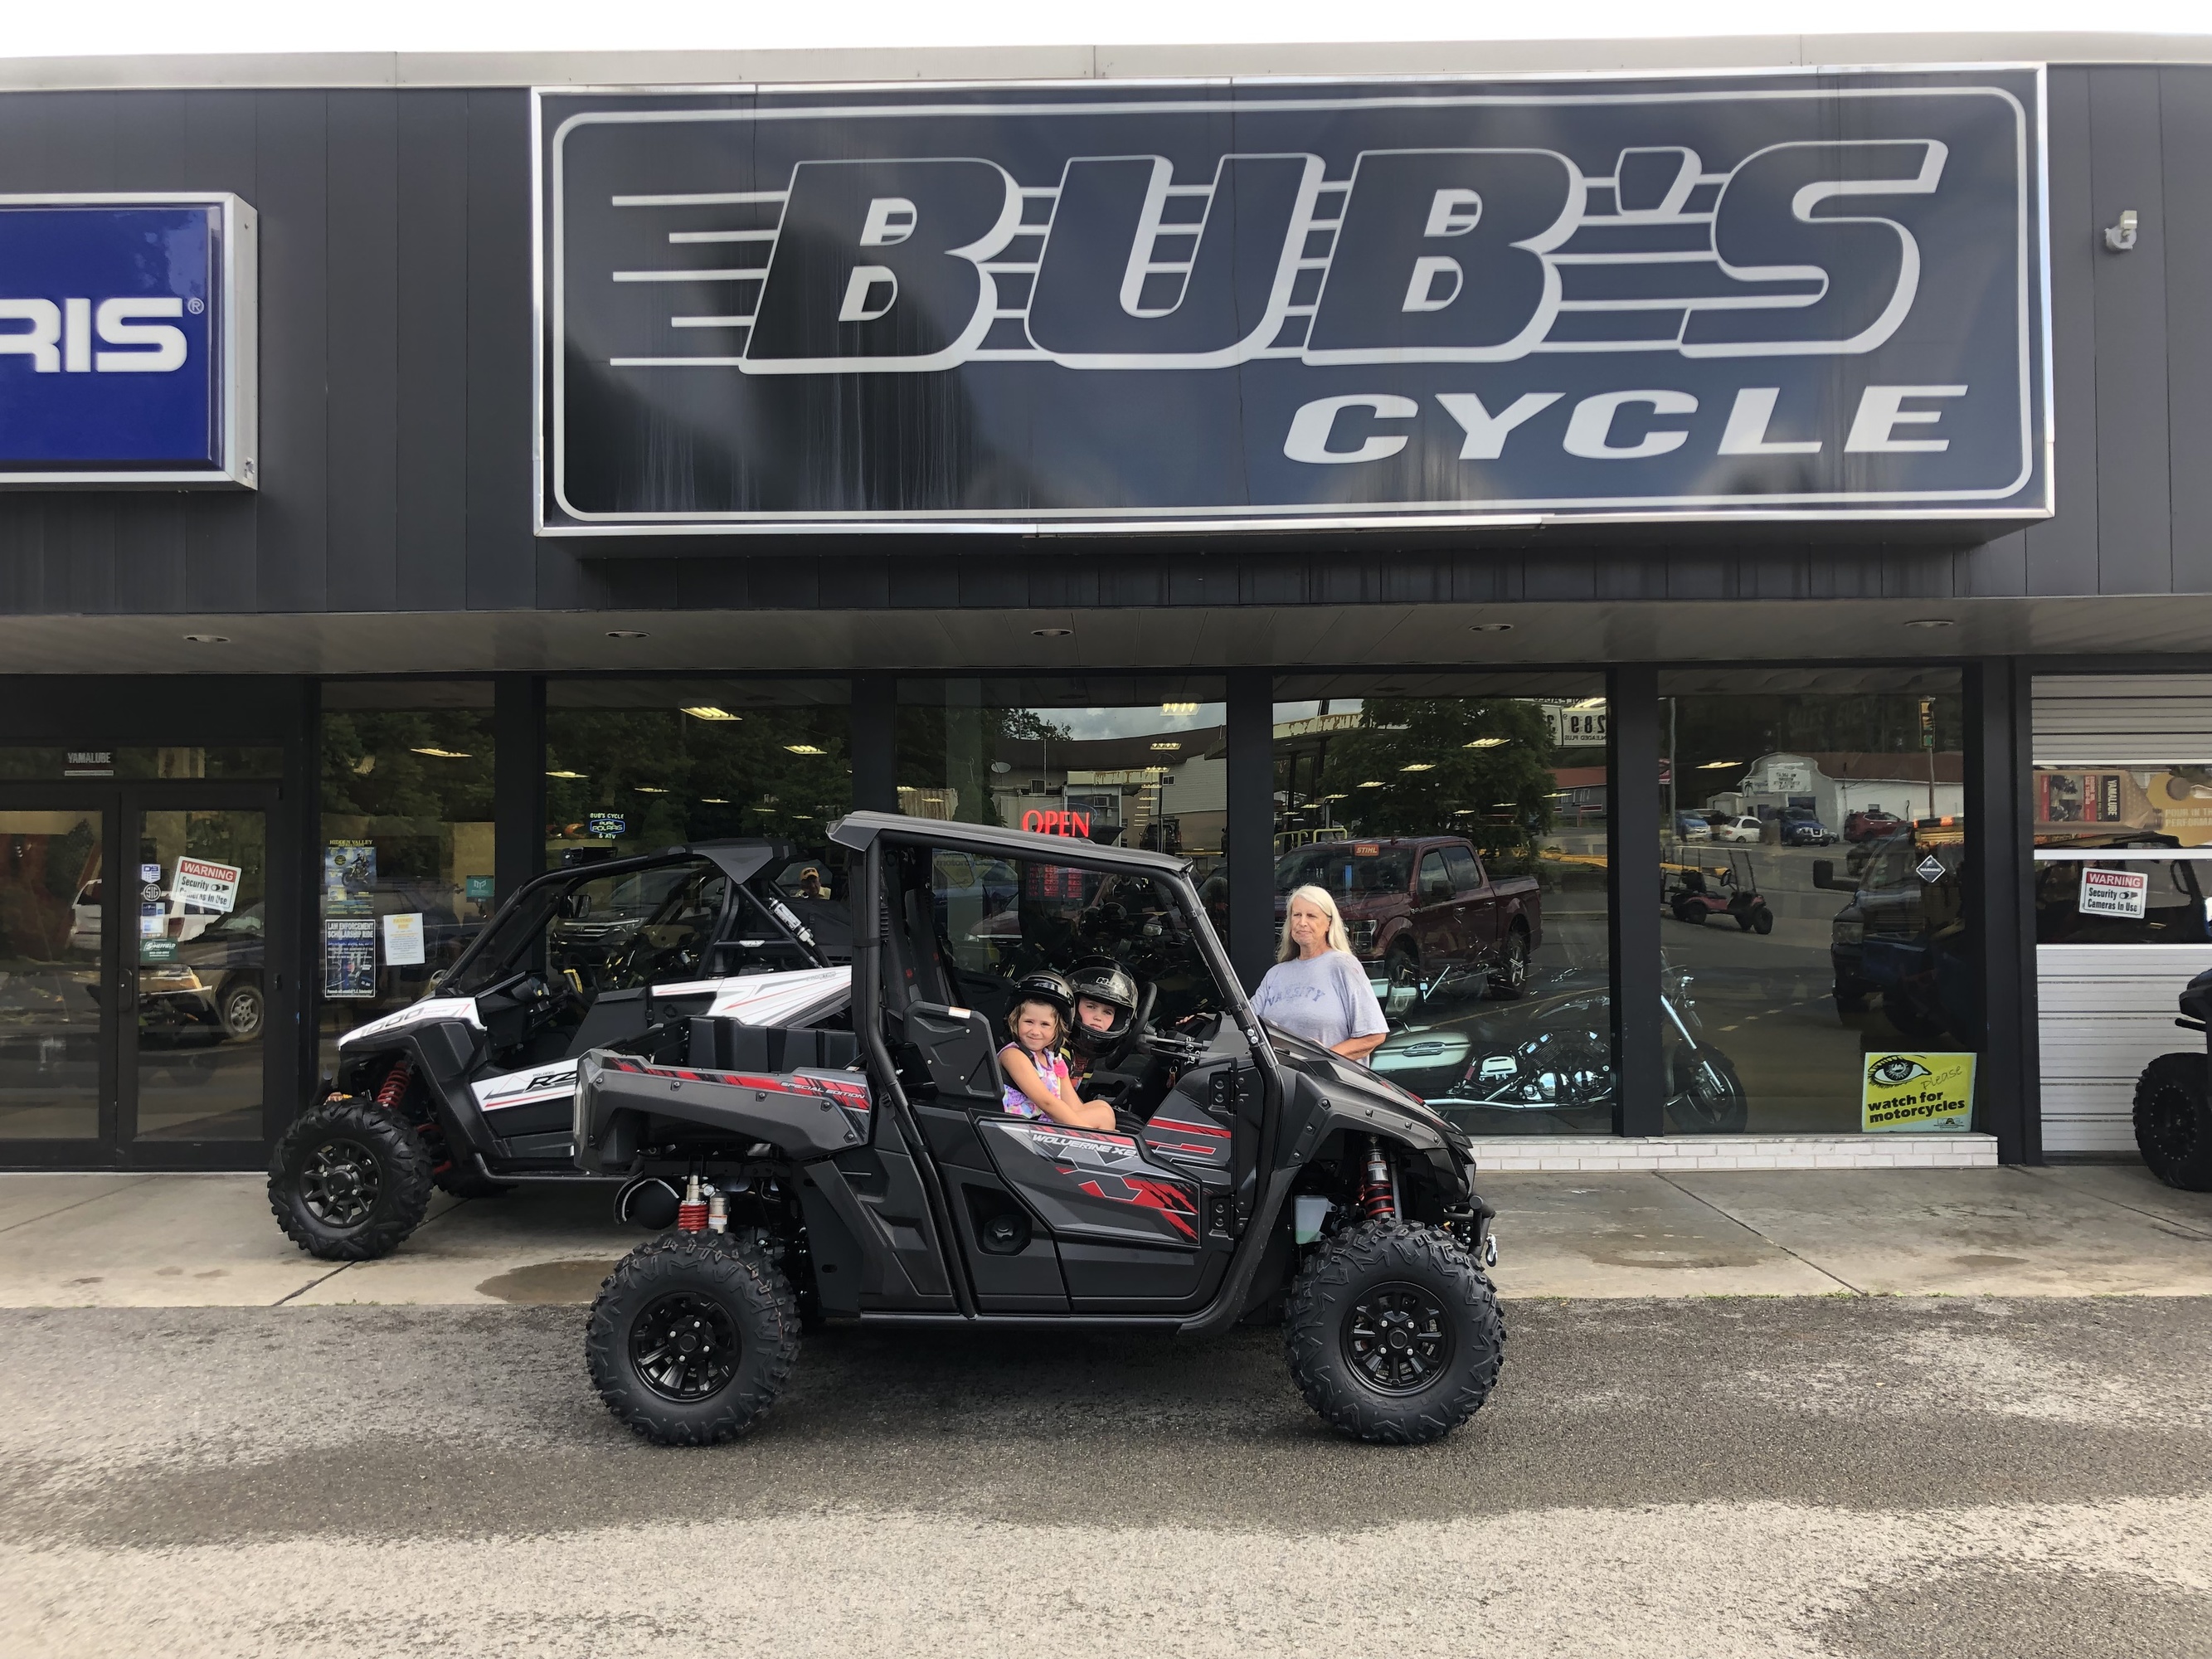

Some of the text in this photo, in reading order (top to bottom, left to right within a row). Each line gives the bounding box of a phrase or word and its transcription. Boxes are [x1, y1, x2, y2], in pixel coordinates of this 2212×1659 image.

[738, 139, 1948, 375] BUB'S
[1283, 384, 1969, 465] CYCLE
[67, 752, 111, 763] YAMALUBE
[2107, 780, 2117, 816] YAMALUBE
[2165, 808, 2188, 817] POUR
[2191, 808, 2200, 816] IN
[1022, 810, 1090, 838] OPEN
[184, 863, 234, 880] WARNING
[2089, 873, 2141, 887] WARNING
[182, 876, 210, 891] Security
[146, 888, 159, 898] SIG
[2088, 887, 2117, 900] Security
[2088, 898, 2116, 910] Cameras
[2126, 902, 2137, 912] Use
[780, 1082, 865, 1099] SPECIAL EDITION
[1868, 1092, 1943, 1112] watch for
[1869, 1100, 1965, 1123] motorcycles
